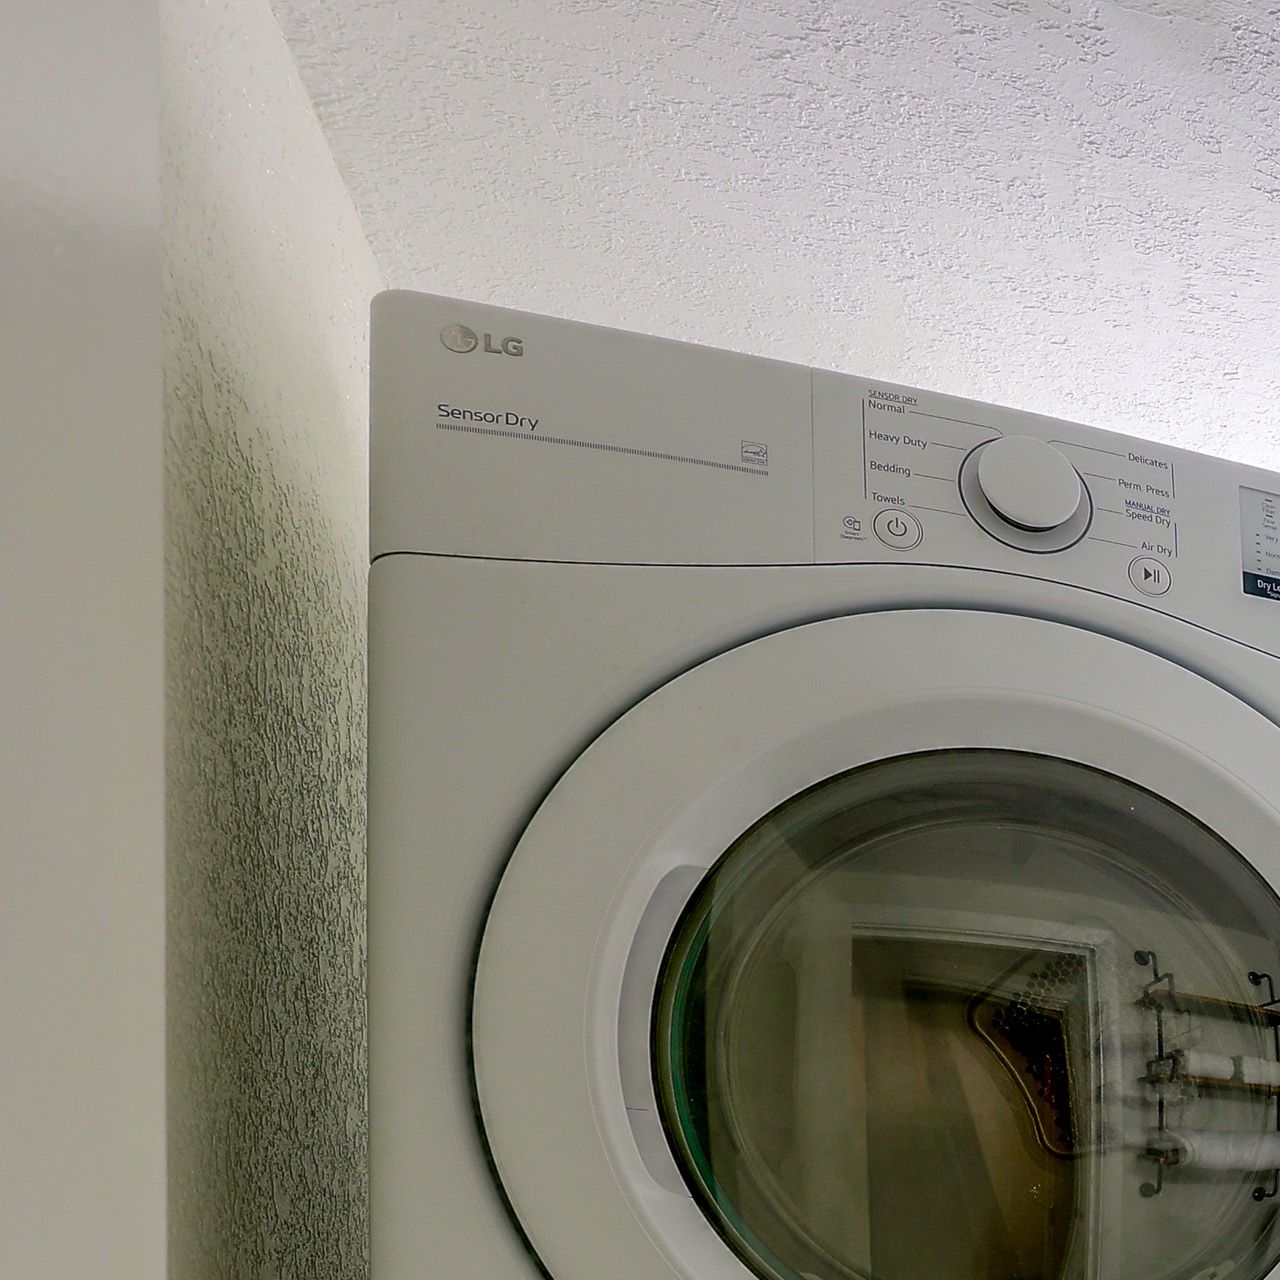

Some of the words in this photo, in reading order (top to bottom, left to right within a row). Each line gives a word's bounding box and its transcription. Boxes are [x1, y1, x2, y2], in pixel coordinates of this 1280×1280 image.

[484, 333, 523, 356] LG
[868, 390, 900, 401] SENSOR
[902, 396, 918, 404] DRY
[868, 400, 905, 414] Normal
[869, 430, 900, 445] Heavy
[904, 436, 928, 450] Duty
[870, 460, 911, 478] Bedding
[1128, 452, 1168, 470] Delicates
[1118, 478, 1144, 492] Perm.
[1146, 484, 1170, 498] Press
[872, 492, 906, 506] Towels
[1125, 499, 1154, 512] MANUAL
[1156, 508, 1170, 516] DRY
[1126, 508, 1152, 522] Speed
[1156, 516, 1171, 528] Dry
[1265, 534, 1278, 544] Very
[1141, 542, 1155, 552] Air
[1156, 544, 1173, 558] Dry
[1257, 580, 1272, 591] Dry
